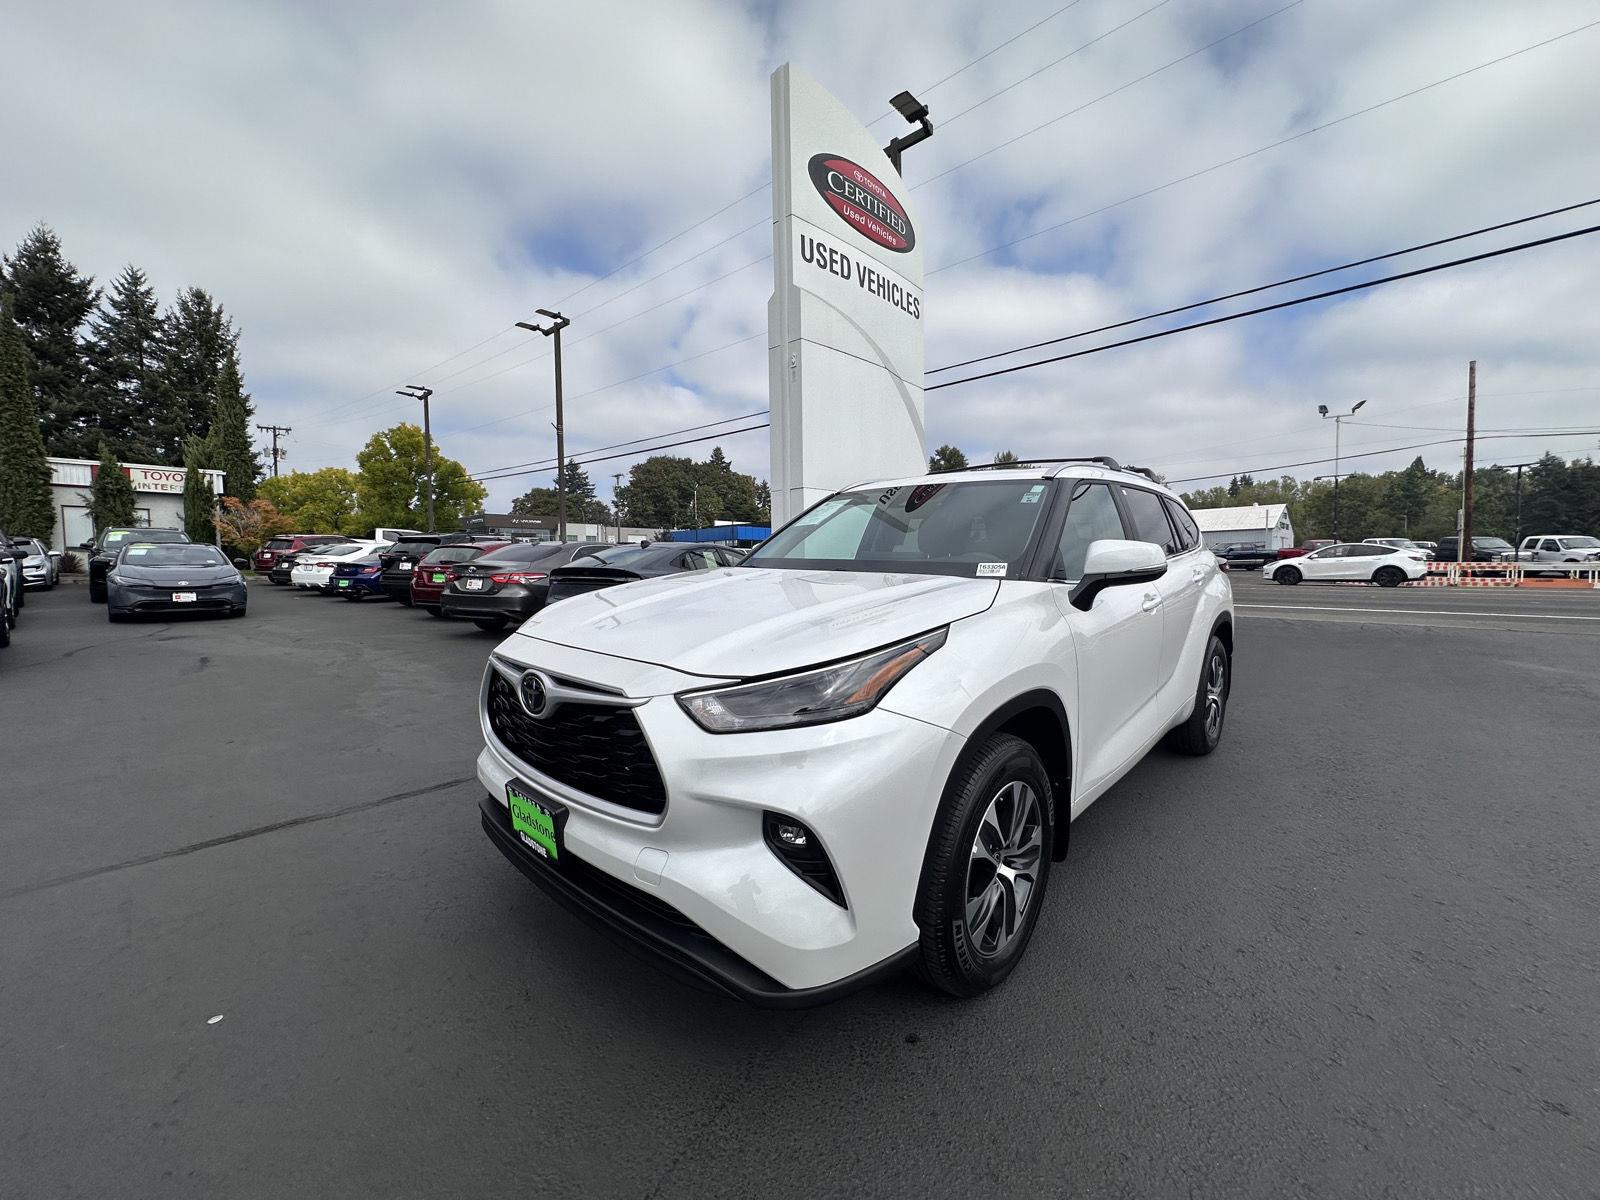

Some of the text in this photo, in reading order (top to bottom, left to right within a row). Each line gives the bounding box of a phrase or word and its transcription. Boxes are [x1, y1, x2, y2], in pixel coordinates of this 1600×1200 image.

[827, 169, 907, 236] CERTIFIED
[862, 176, 888, 200] TOYOTA
[843, 204, 897, 246] Used Vehicles
[800, 233, 921, 321] USED VEHICLES
[140, 471, 186, 482] TOYO
[512, 804, 557, 843] Gladstone
